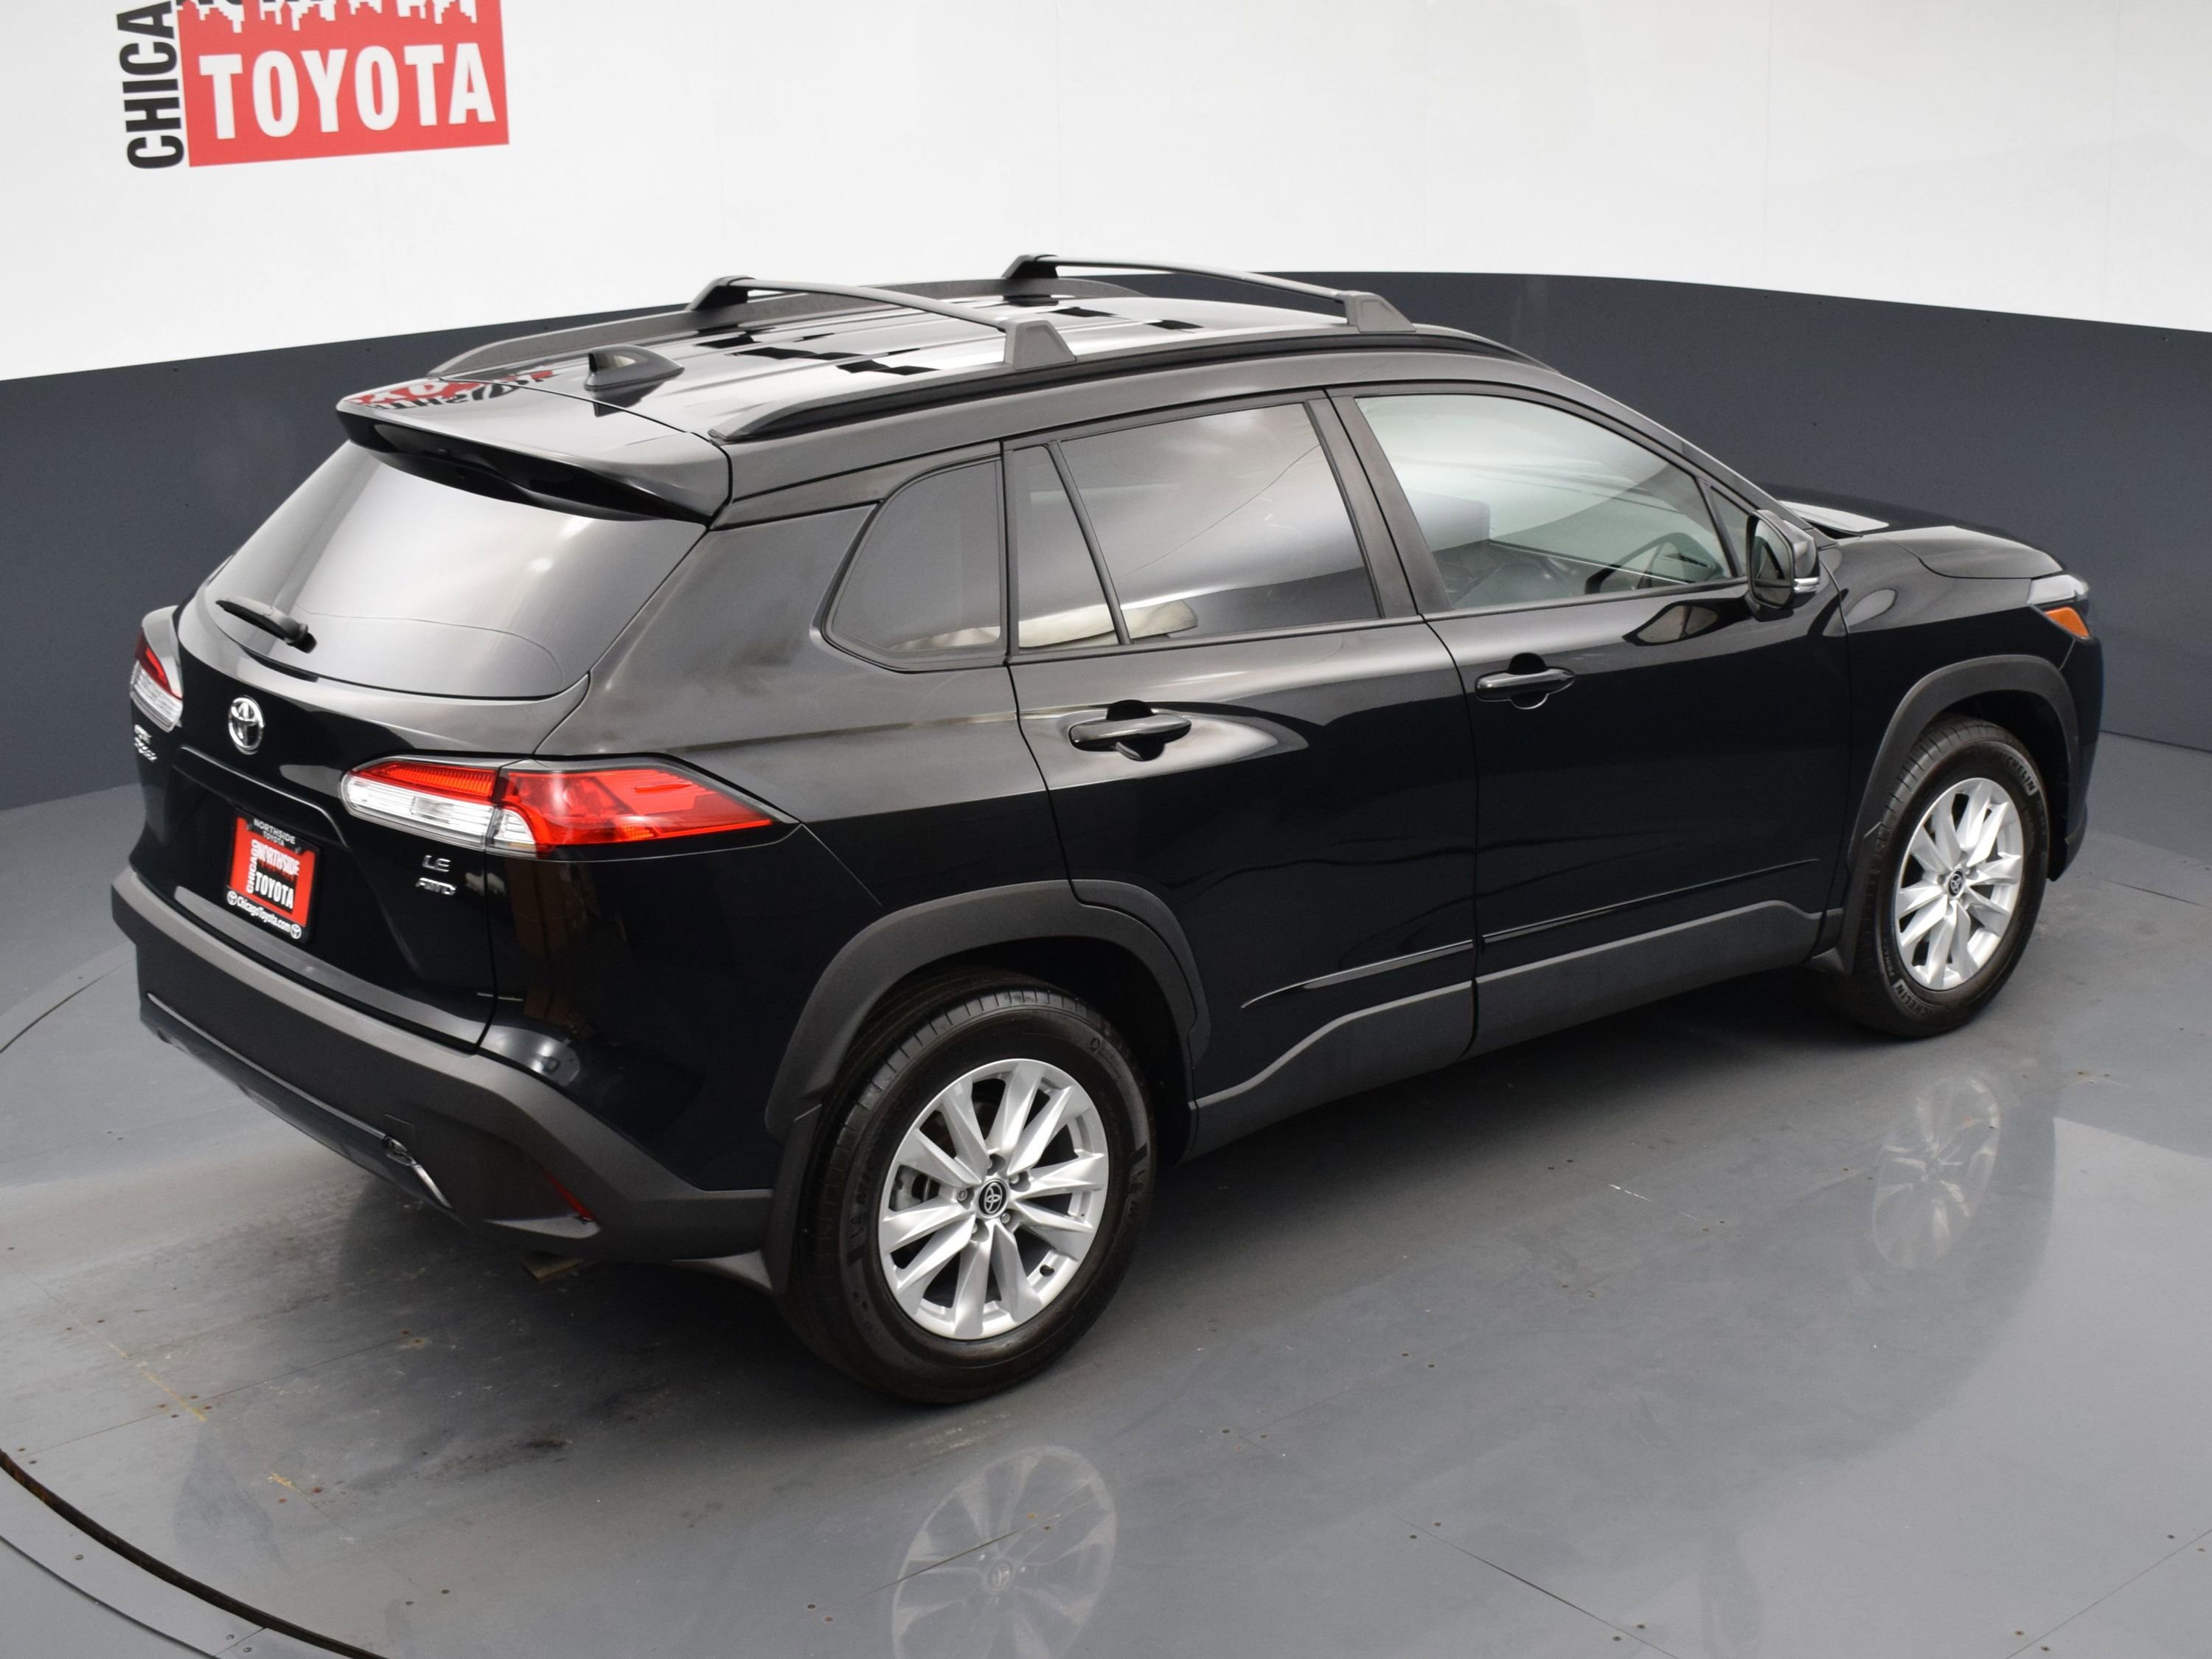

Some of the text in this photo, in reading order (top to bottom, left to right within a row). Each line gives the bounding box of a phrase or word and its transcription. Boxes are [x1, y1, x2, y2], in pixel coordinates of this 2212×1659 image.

[199, 42, 495, 140] TOYOTA
[254, 818, 296, 845] NORTHSIDE
[263, 830, 285, 846] TOYOTA
[422, 855, 451, 872] LE
[255, 872, 294, 909] TOYOTA
[237, 896, 291, 933] ChicagoToyota.com
